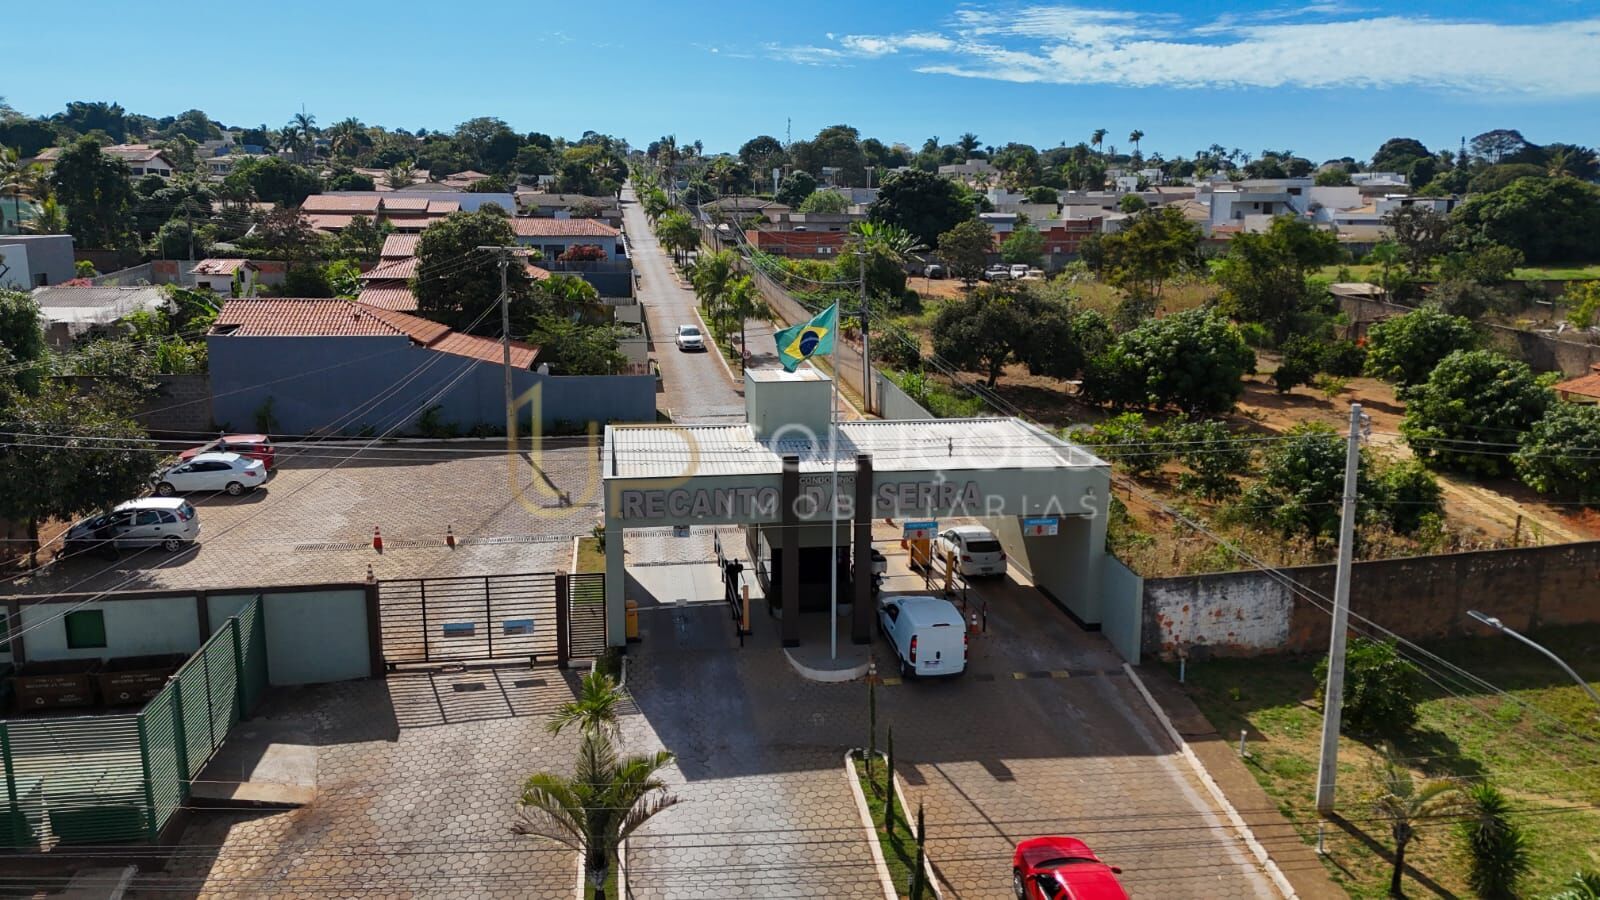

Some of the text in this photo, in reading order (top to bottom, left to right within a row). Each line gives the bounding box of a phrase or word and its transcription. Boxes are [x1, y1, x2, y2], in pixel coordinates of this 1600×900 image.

[622, 481, 981, 520] RECANTO DA SERRA
